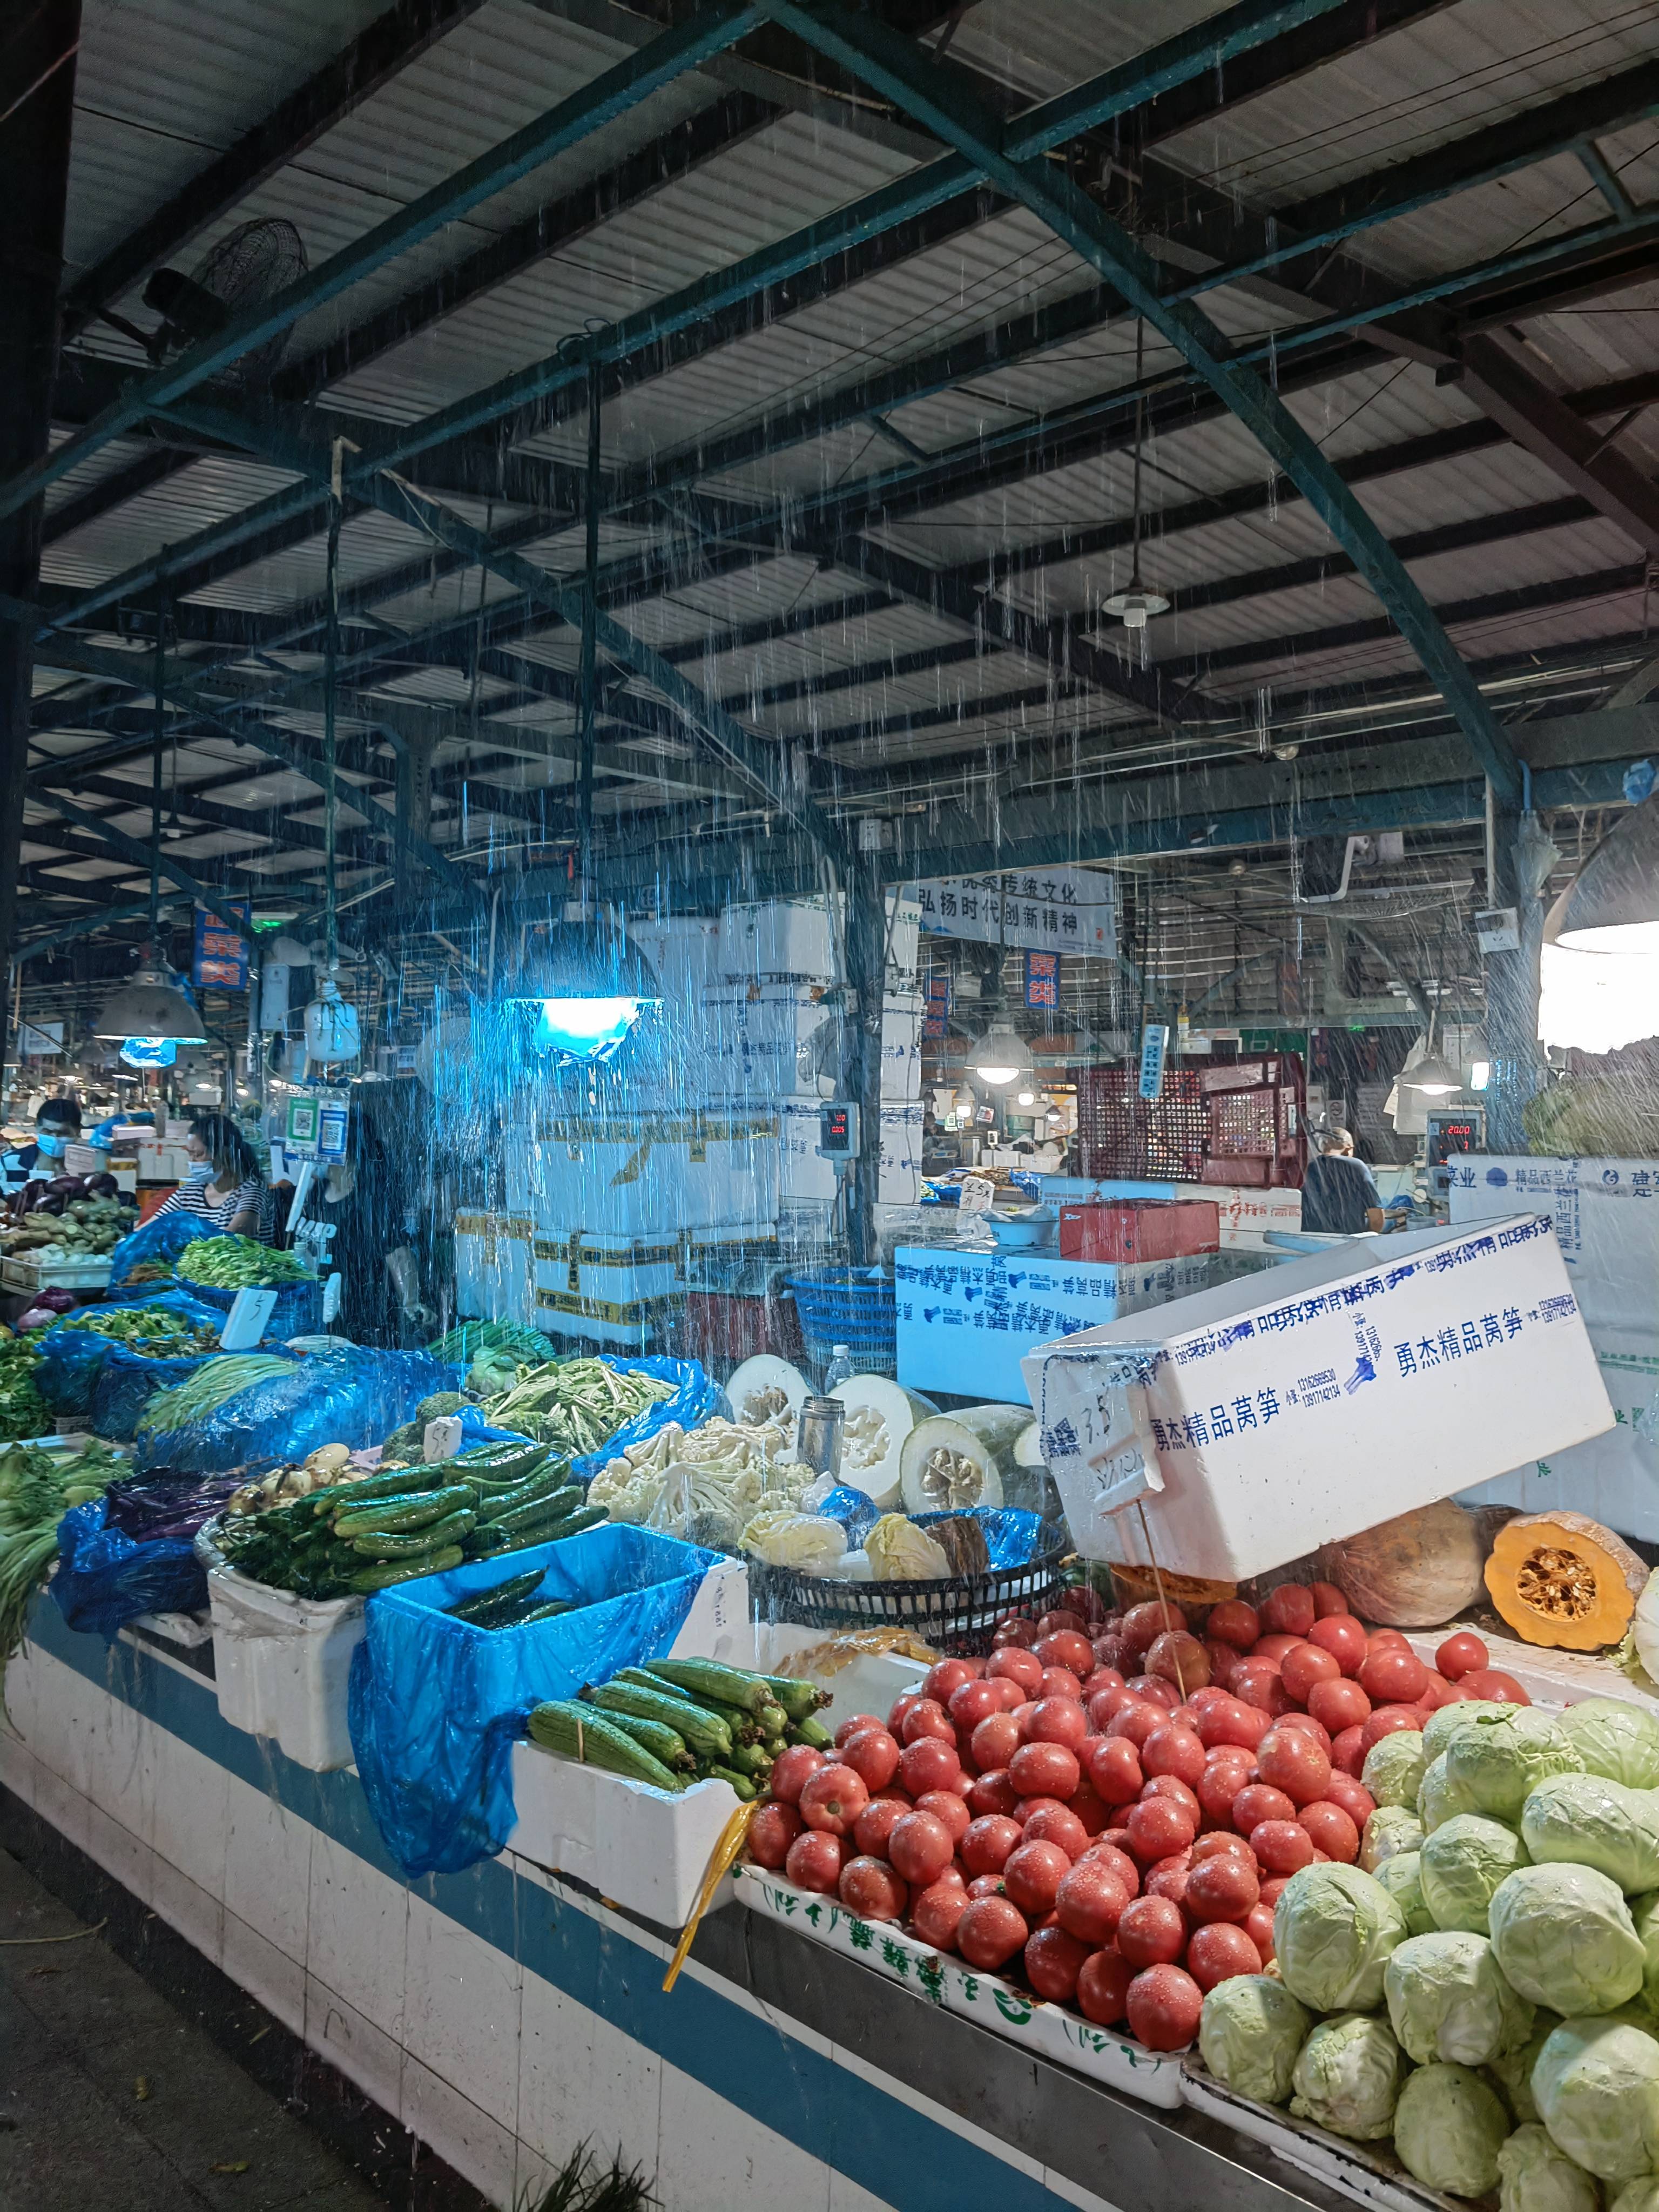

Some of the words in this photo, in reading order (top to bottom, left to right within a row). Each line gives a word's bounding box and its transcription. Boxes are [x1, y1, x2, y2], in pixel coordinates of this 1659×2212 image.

[918, 888, 1077, 935] 弘扬时代创新精神
[1448, 1125, 1470, 1135] 20.00
[1394, 1306, 1523, 1378] 勇杰精品莴笋
[1150, 1386, 1280, 1452] 勇杰精品莴笋
